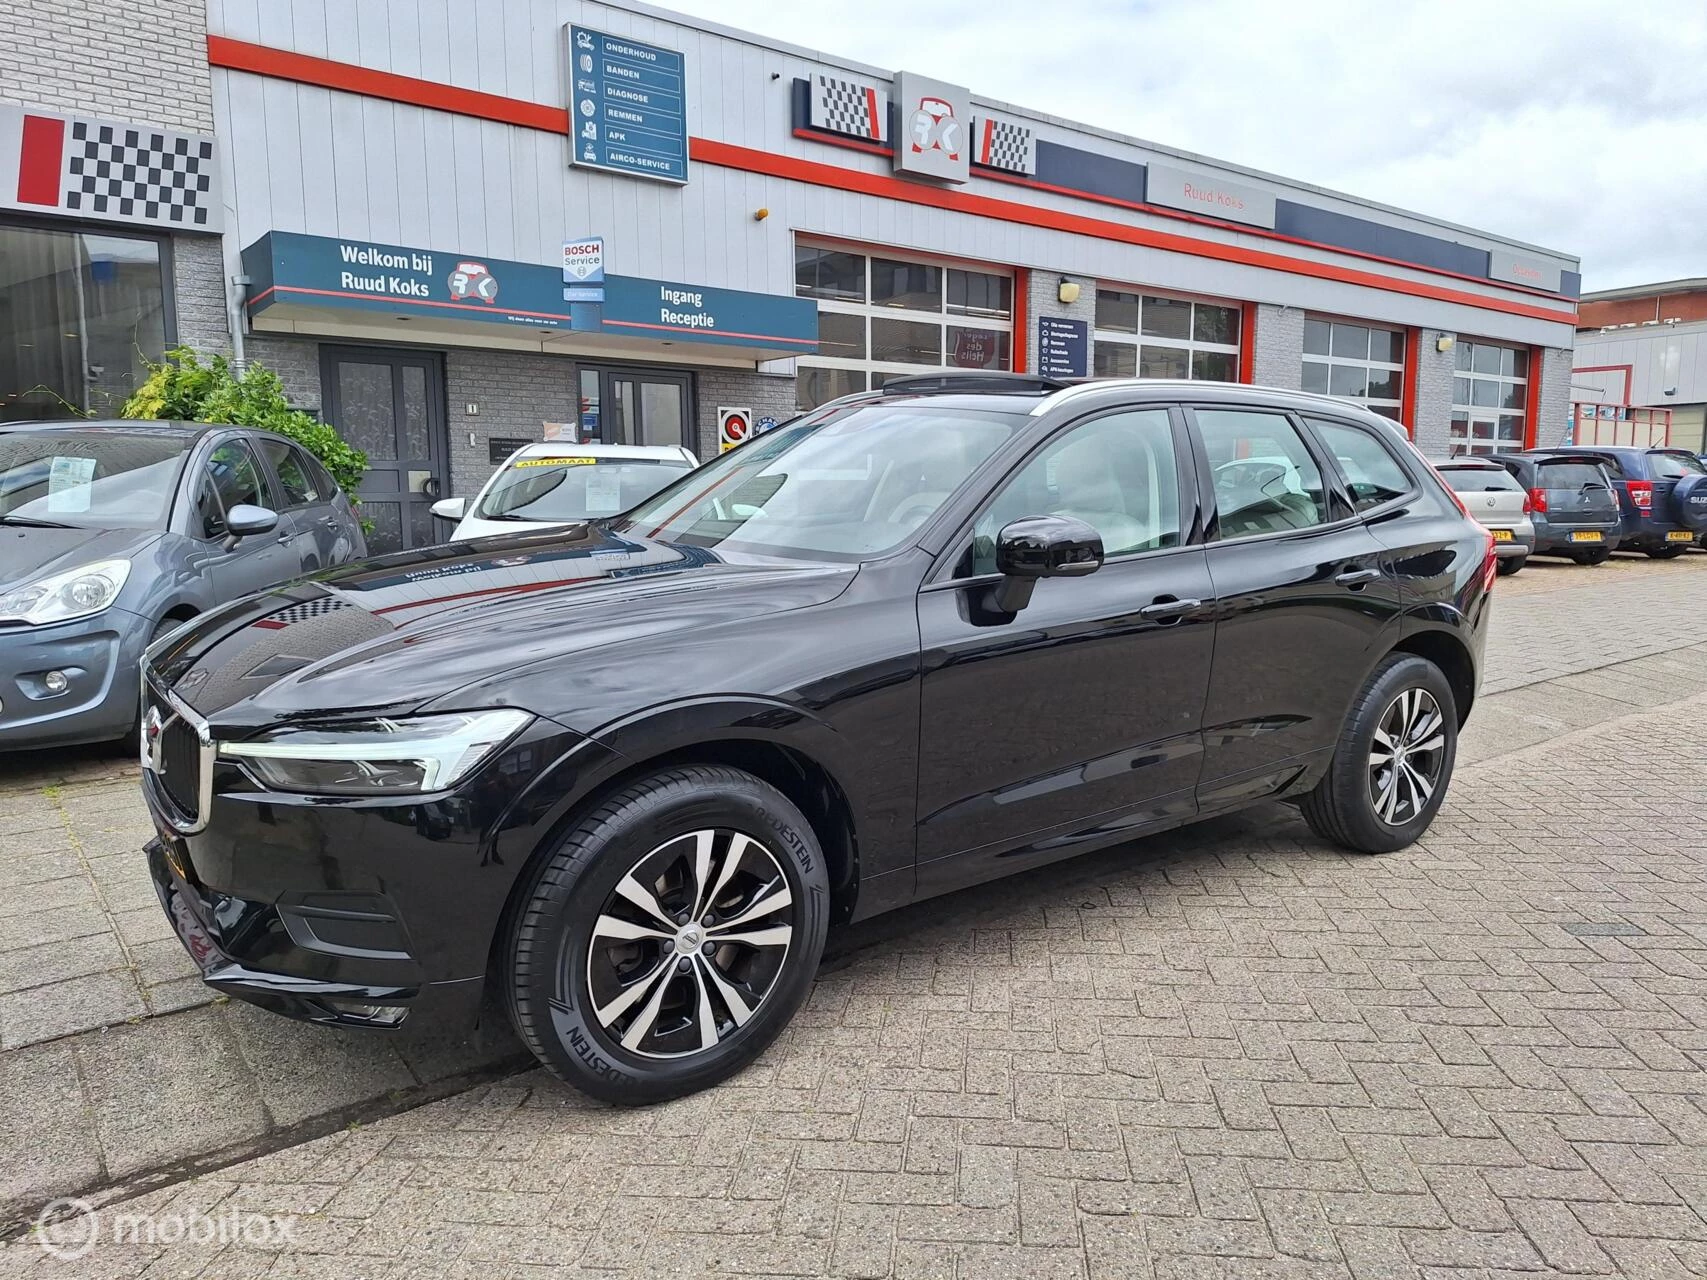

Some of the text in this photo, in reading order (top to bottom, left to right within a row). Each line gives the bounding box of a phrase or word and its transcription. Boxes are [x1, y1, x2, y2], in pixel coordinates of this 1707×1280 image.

[606, 42, 657, 61] ONDERHOUD
[606, 65, 640, 79] BANDEN
[607, 87, 649, 102] DIAGNOSE
[608, 109, 643, 123] REMMEN
[608, 131, 626, 141] APK
[610, 153, 671, 171] AIRCO-SERVICE
[1184, 183, 1214, 203] Ruud
[564, 244, 600, 256] BOSCH
[340, 245, 433, 276] Welkom bij
[564, 256, 600, 266] Service
[341, 272, 430, 297] Ruud Koks
[660, 285, 703, 308] Ingang
[660, 308, 715, 329] Receptie
[521, 459, 590, 467] AUTOMAAT
